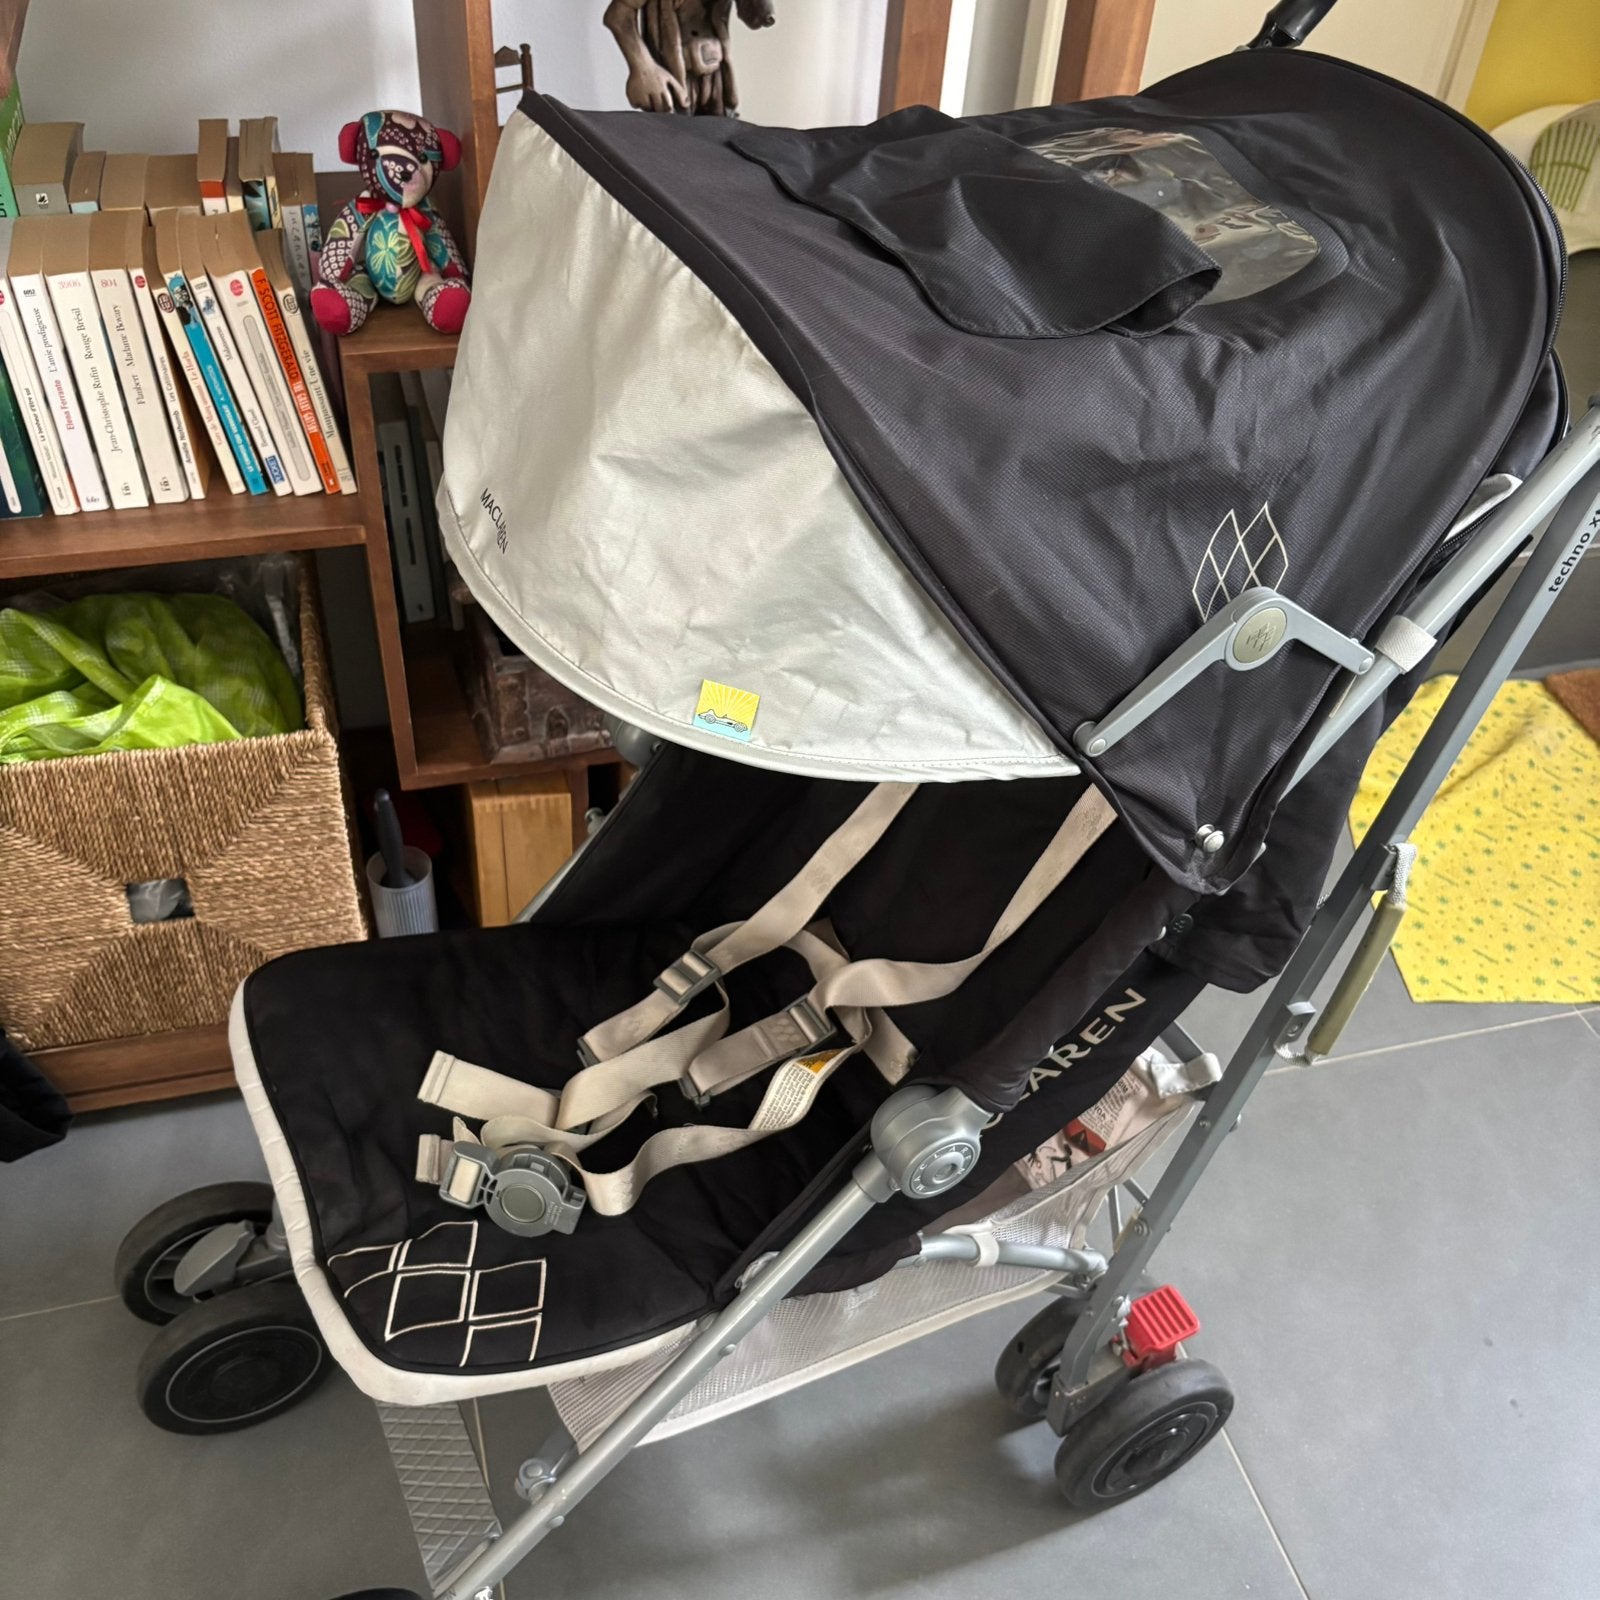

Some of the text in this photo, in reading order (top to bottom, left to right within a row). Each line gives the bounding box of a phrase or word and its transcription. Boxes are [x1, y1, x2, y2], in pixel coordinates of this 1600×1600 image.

[33, 307, 58, 373] L'amie prodigieuse
[112, 304, 146, 405] Flaubert Madame Bovary
[259, 289, 279, 320] SCOTT
[272, 323, 299, 380] FITZGERALD
[54, 379, 75, 430] Elena Ferrante
[71, 307, 123, 453] Jean-Christophe Rufin Rouge Brésil
[303, 350, 335, 439] Maupassant Une vie
[33, 413, 43, 434] bonheur
[40, 431, 46, 441] Le
[173, 410, 186, 440] Nothomb
[1548, 532, 1591, 593] techno
[913, 1145, 972, 1192] MACLAREN
